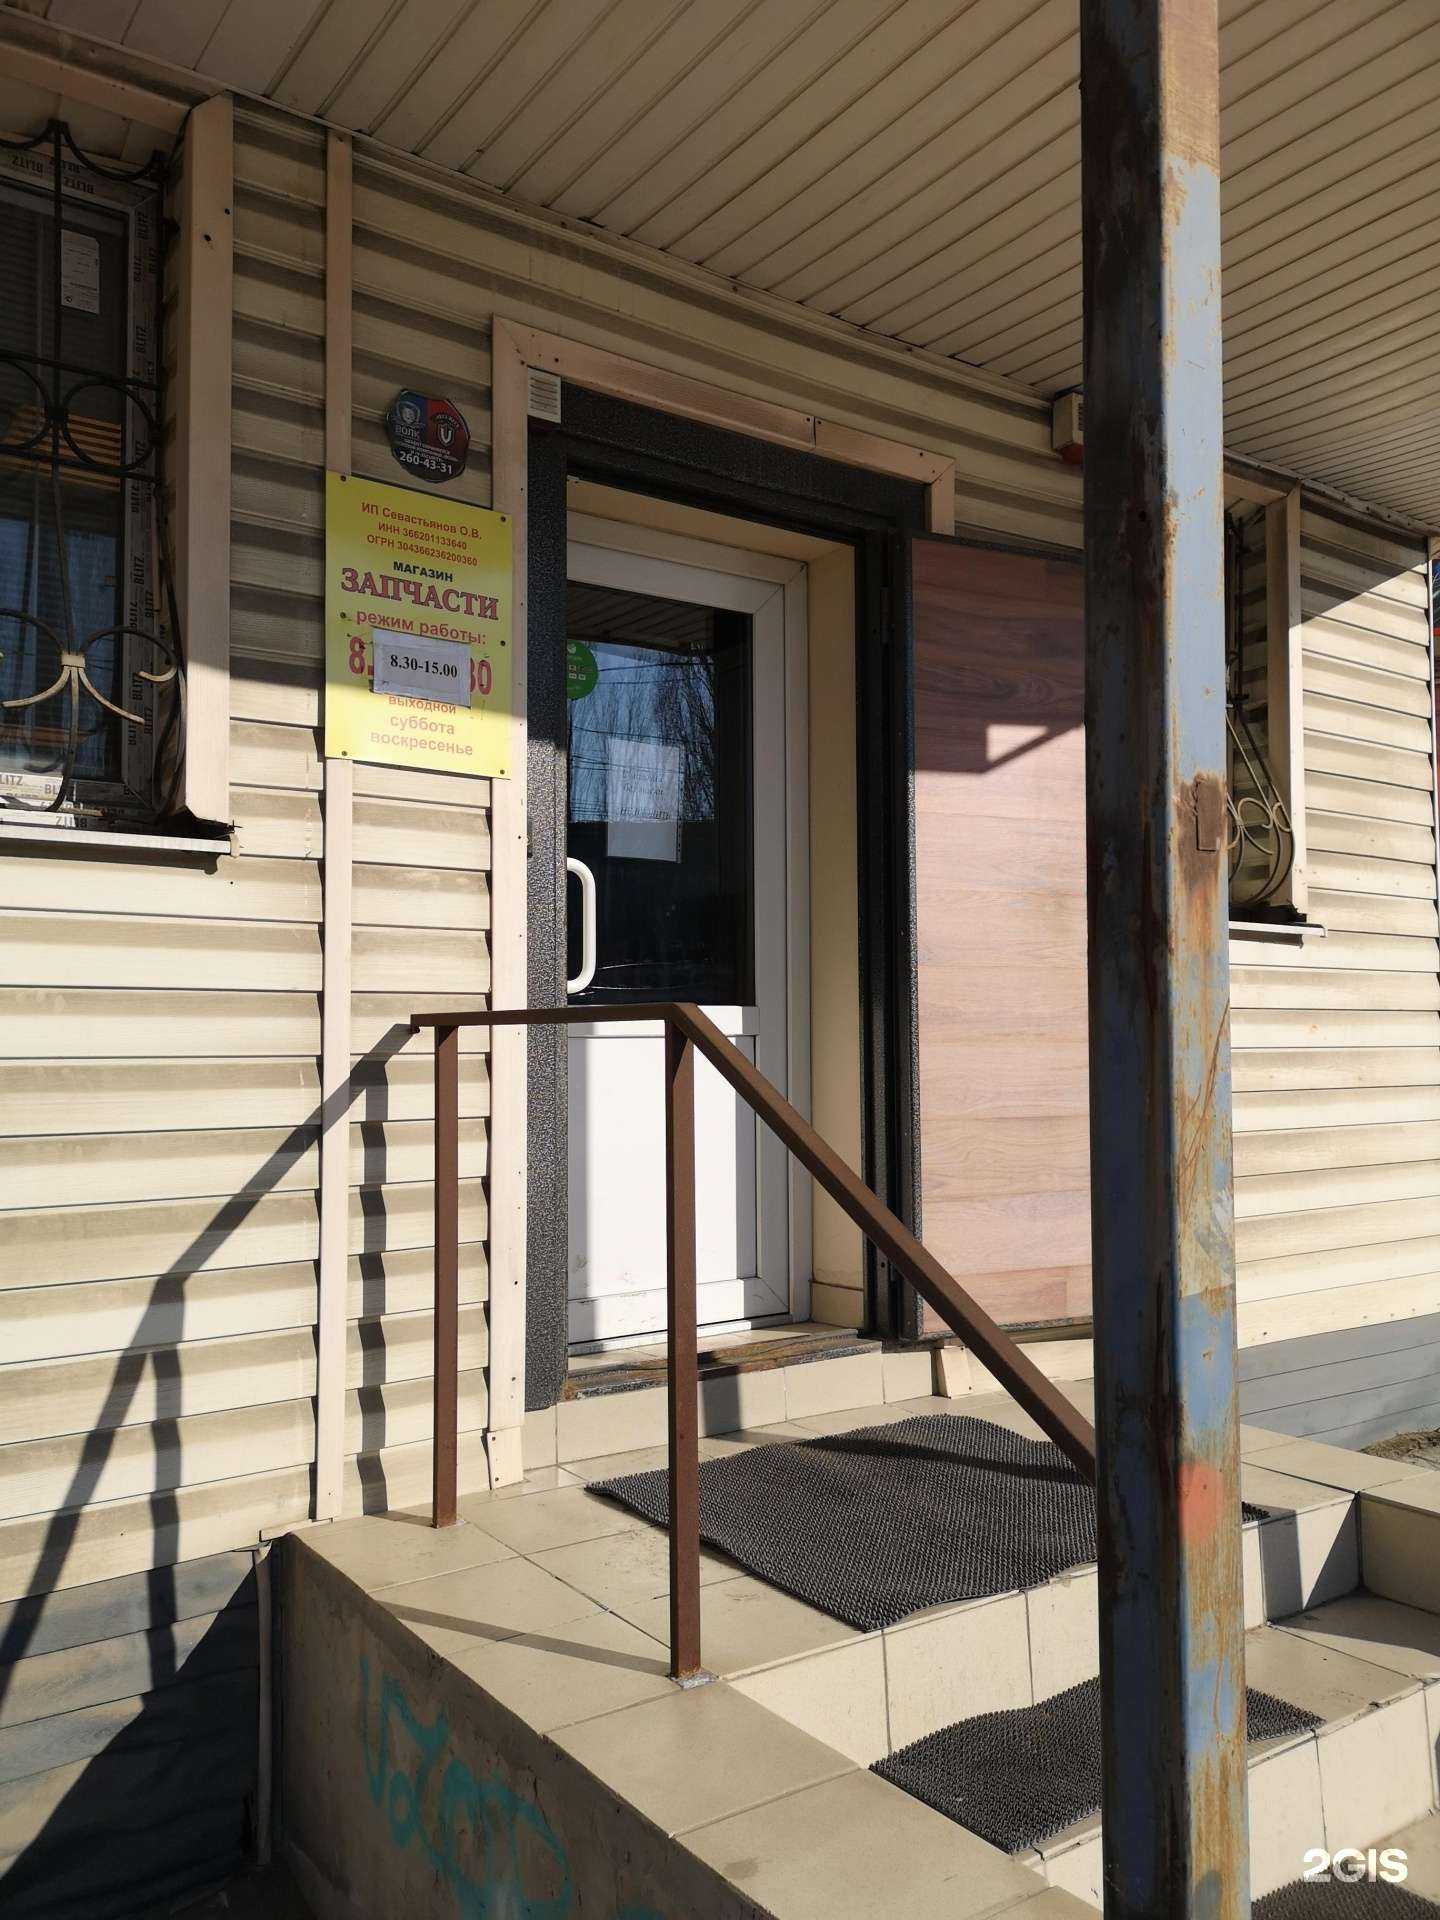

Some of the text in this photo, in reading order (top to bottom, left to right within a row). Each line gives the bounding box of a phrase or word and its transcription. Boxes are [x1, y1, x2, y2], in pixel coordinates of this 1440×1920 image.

[63, 177, 95, 194] BLITZ
[136, 326, 146, 353] BLITZ
[400, 451, 452, 474] 260-43-31
[361, 502, 482, 540] ИП Севастьянов О.В.
[378, 521, 400, 535] ИНН
[367, 534, 395, 548] ОГРН
[134, 554, 145, 585] BLITZ
[393, 561, 453, 582] МАГАЗИН
[341, 567, 499, 620] ЗАПЧАСТИ
[356, 611, 486, 645] режим работы:
[390, 654, 458, 679] 8.30-15.00
[388, 696, 456, 715] выходной
[390, 715, 455, 735] суббота
[370, 731, 473, 755] воскресенье
[0, 774, 23, 786] LITZ
